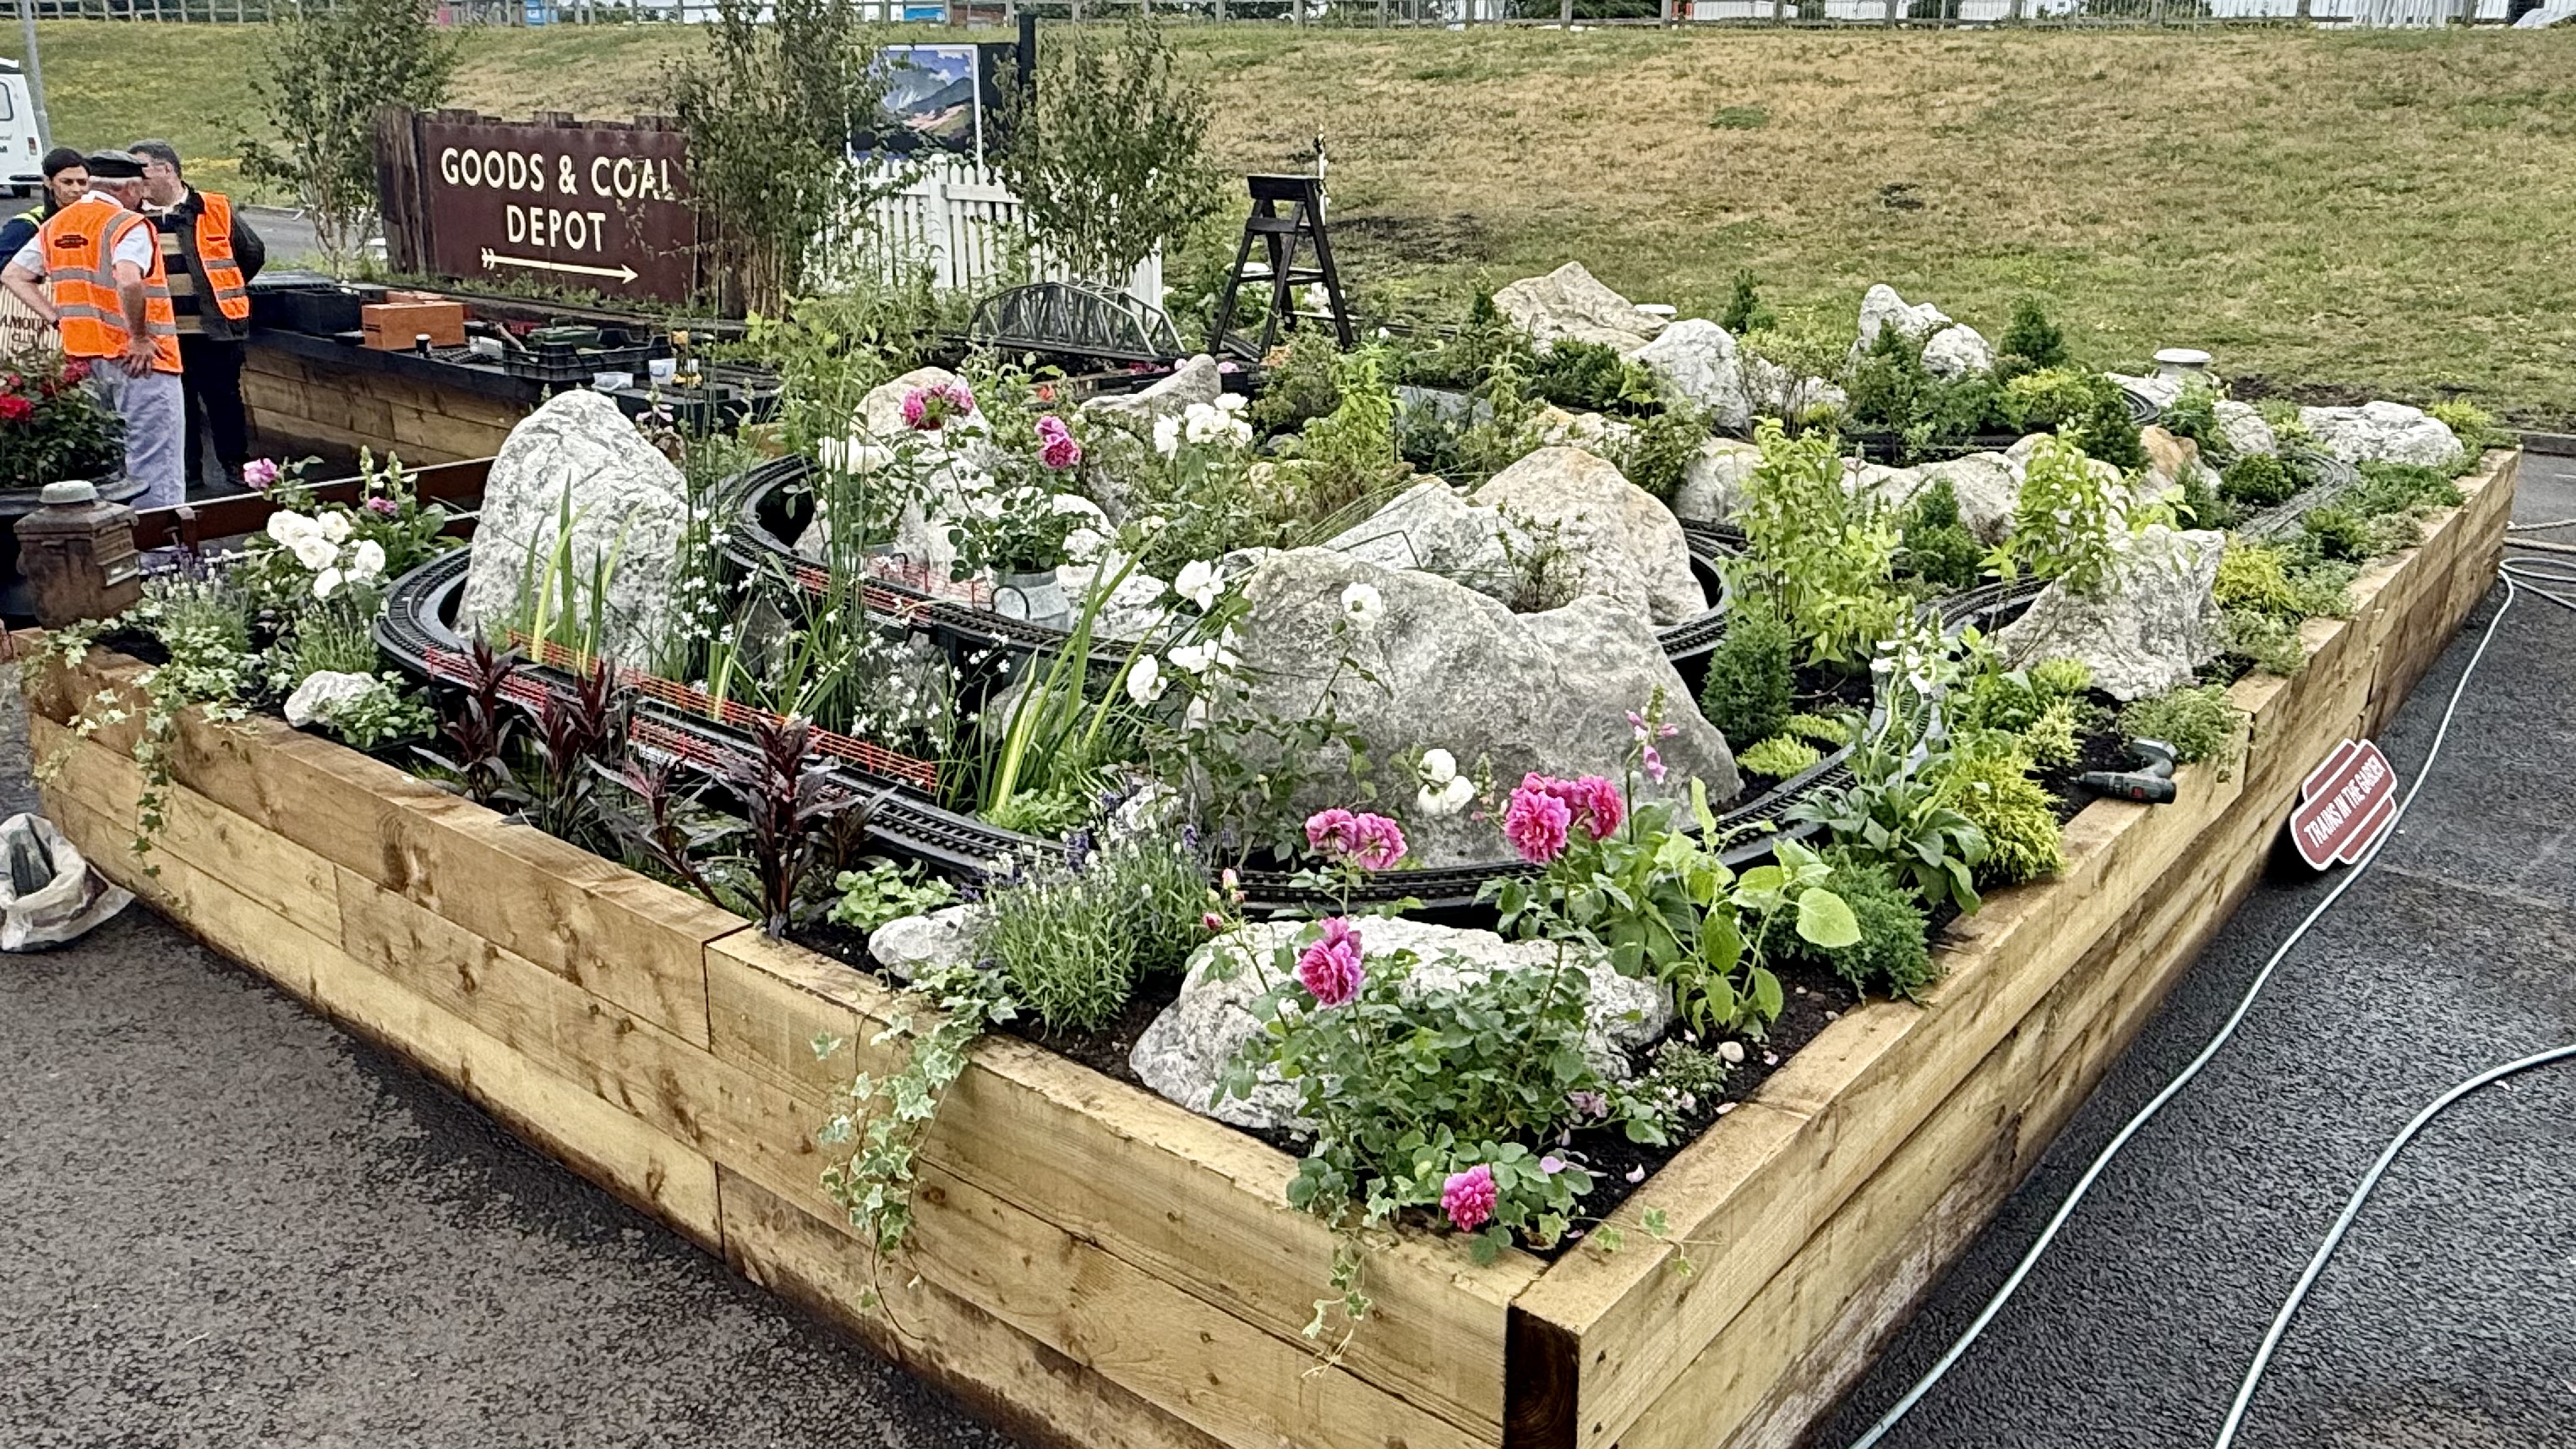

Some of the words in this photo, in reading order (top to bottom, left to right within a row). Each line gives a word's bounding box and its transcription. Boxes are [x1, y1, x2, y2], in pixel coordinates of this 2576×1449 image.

[440, 147, 545, 193] GOODS
[558, 155, 579, 196] &
[590, 156, 676, 201] COAL
[505, 204, 607, 253] DEPOT
[2342, 779, 2366, 809] THE
[2354, 753, 2386, 795] GARDEN
[2303, 802, 2344, 848] TRAINS
[2333, 795, 2353, 819] IN
